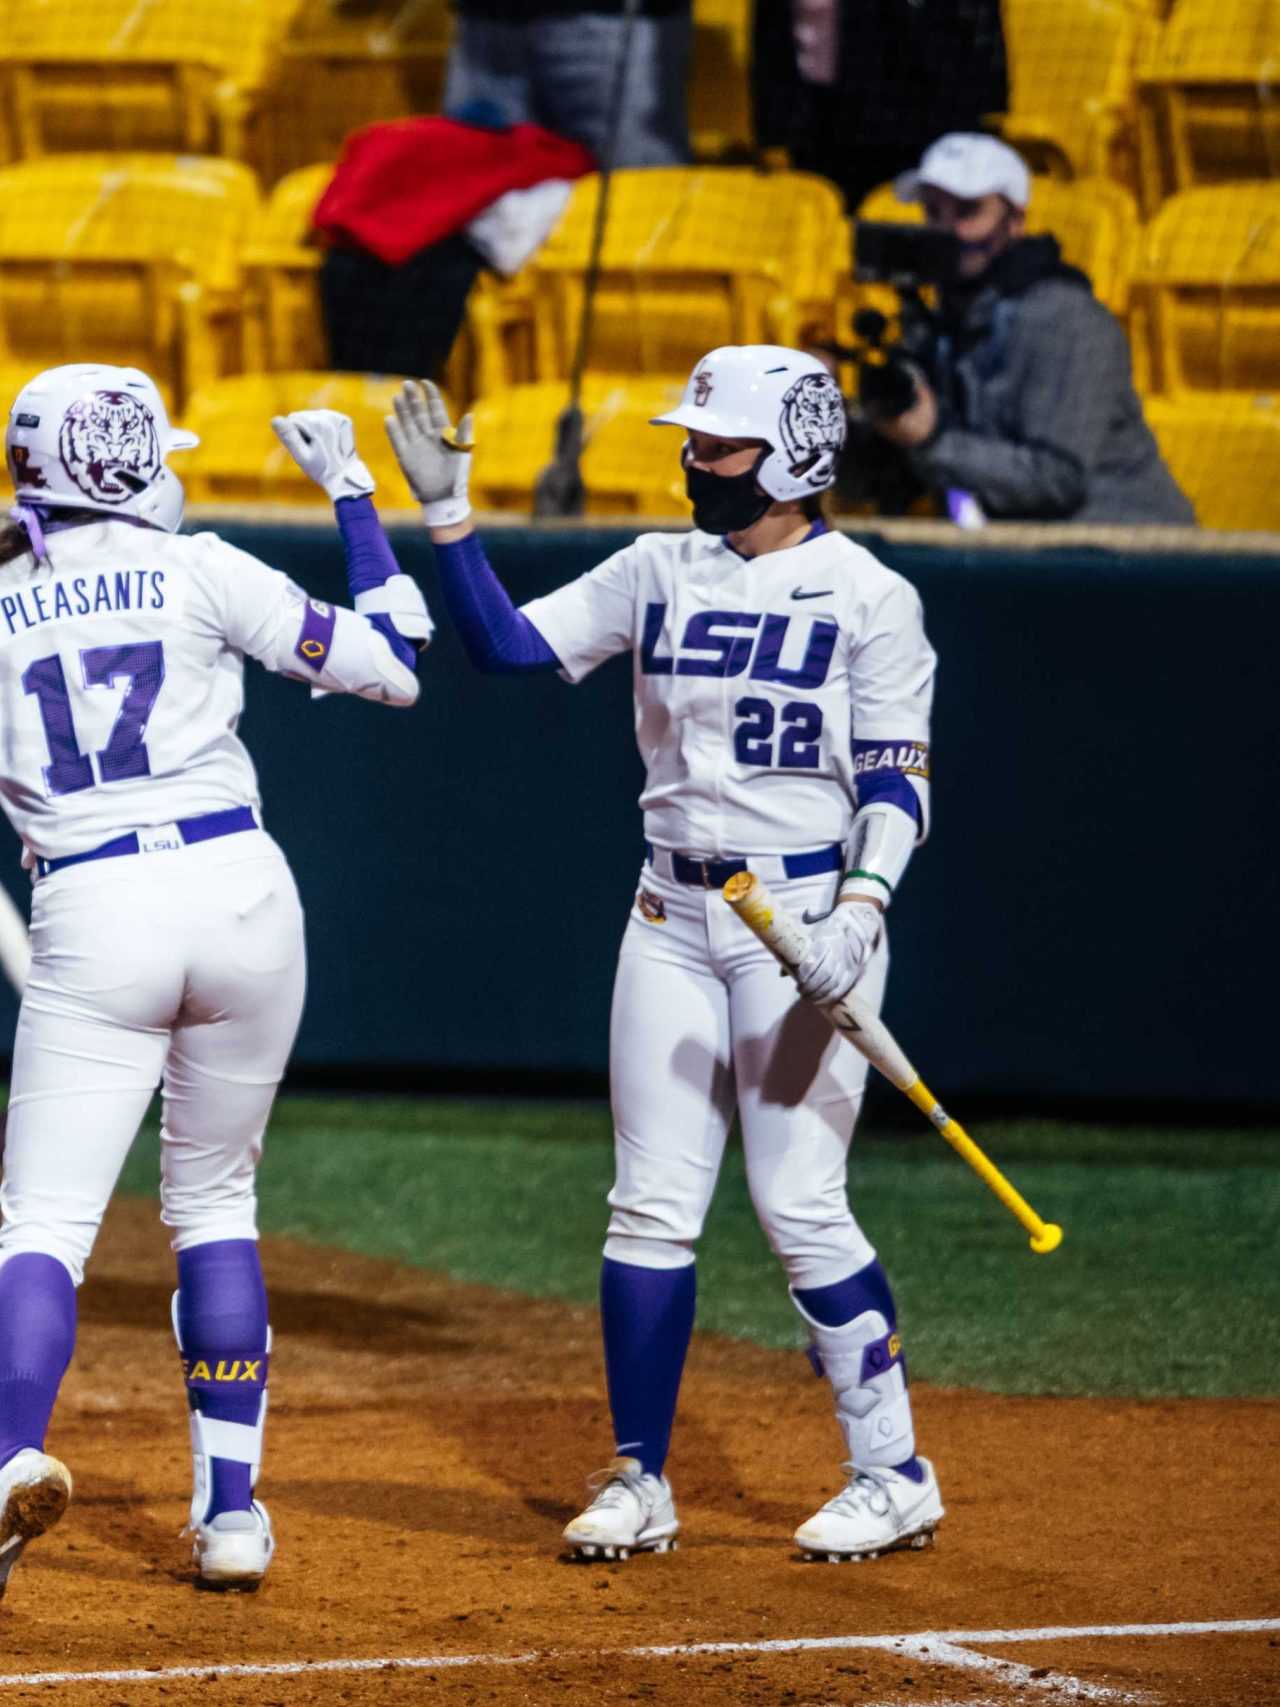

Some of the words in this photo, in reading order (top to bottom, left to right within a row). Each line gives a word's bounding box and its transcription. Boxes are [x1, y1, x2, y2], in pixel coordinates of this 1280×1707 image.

[0, 570, 165, 635] PLEASANTS
[640, 602, 839, 690] LSU
[21, 641, 166, 797] 17
[734, 697, 823, 769] 22
[853, 746, 927, 773] GEAUX
[142, 839, 180, 853] LSU
